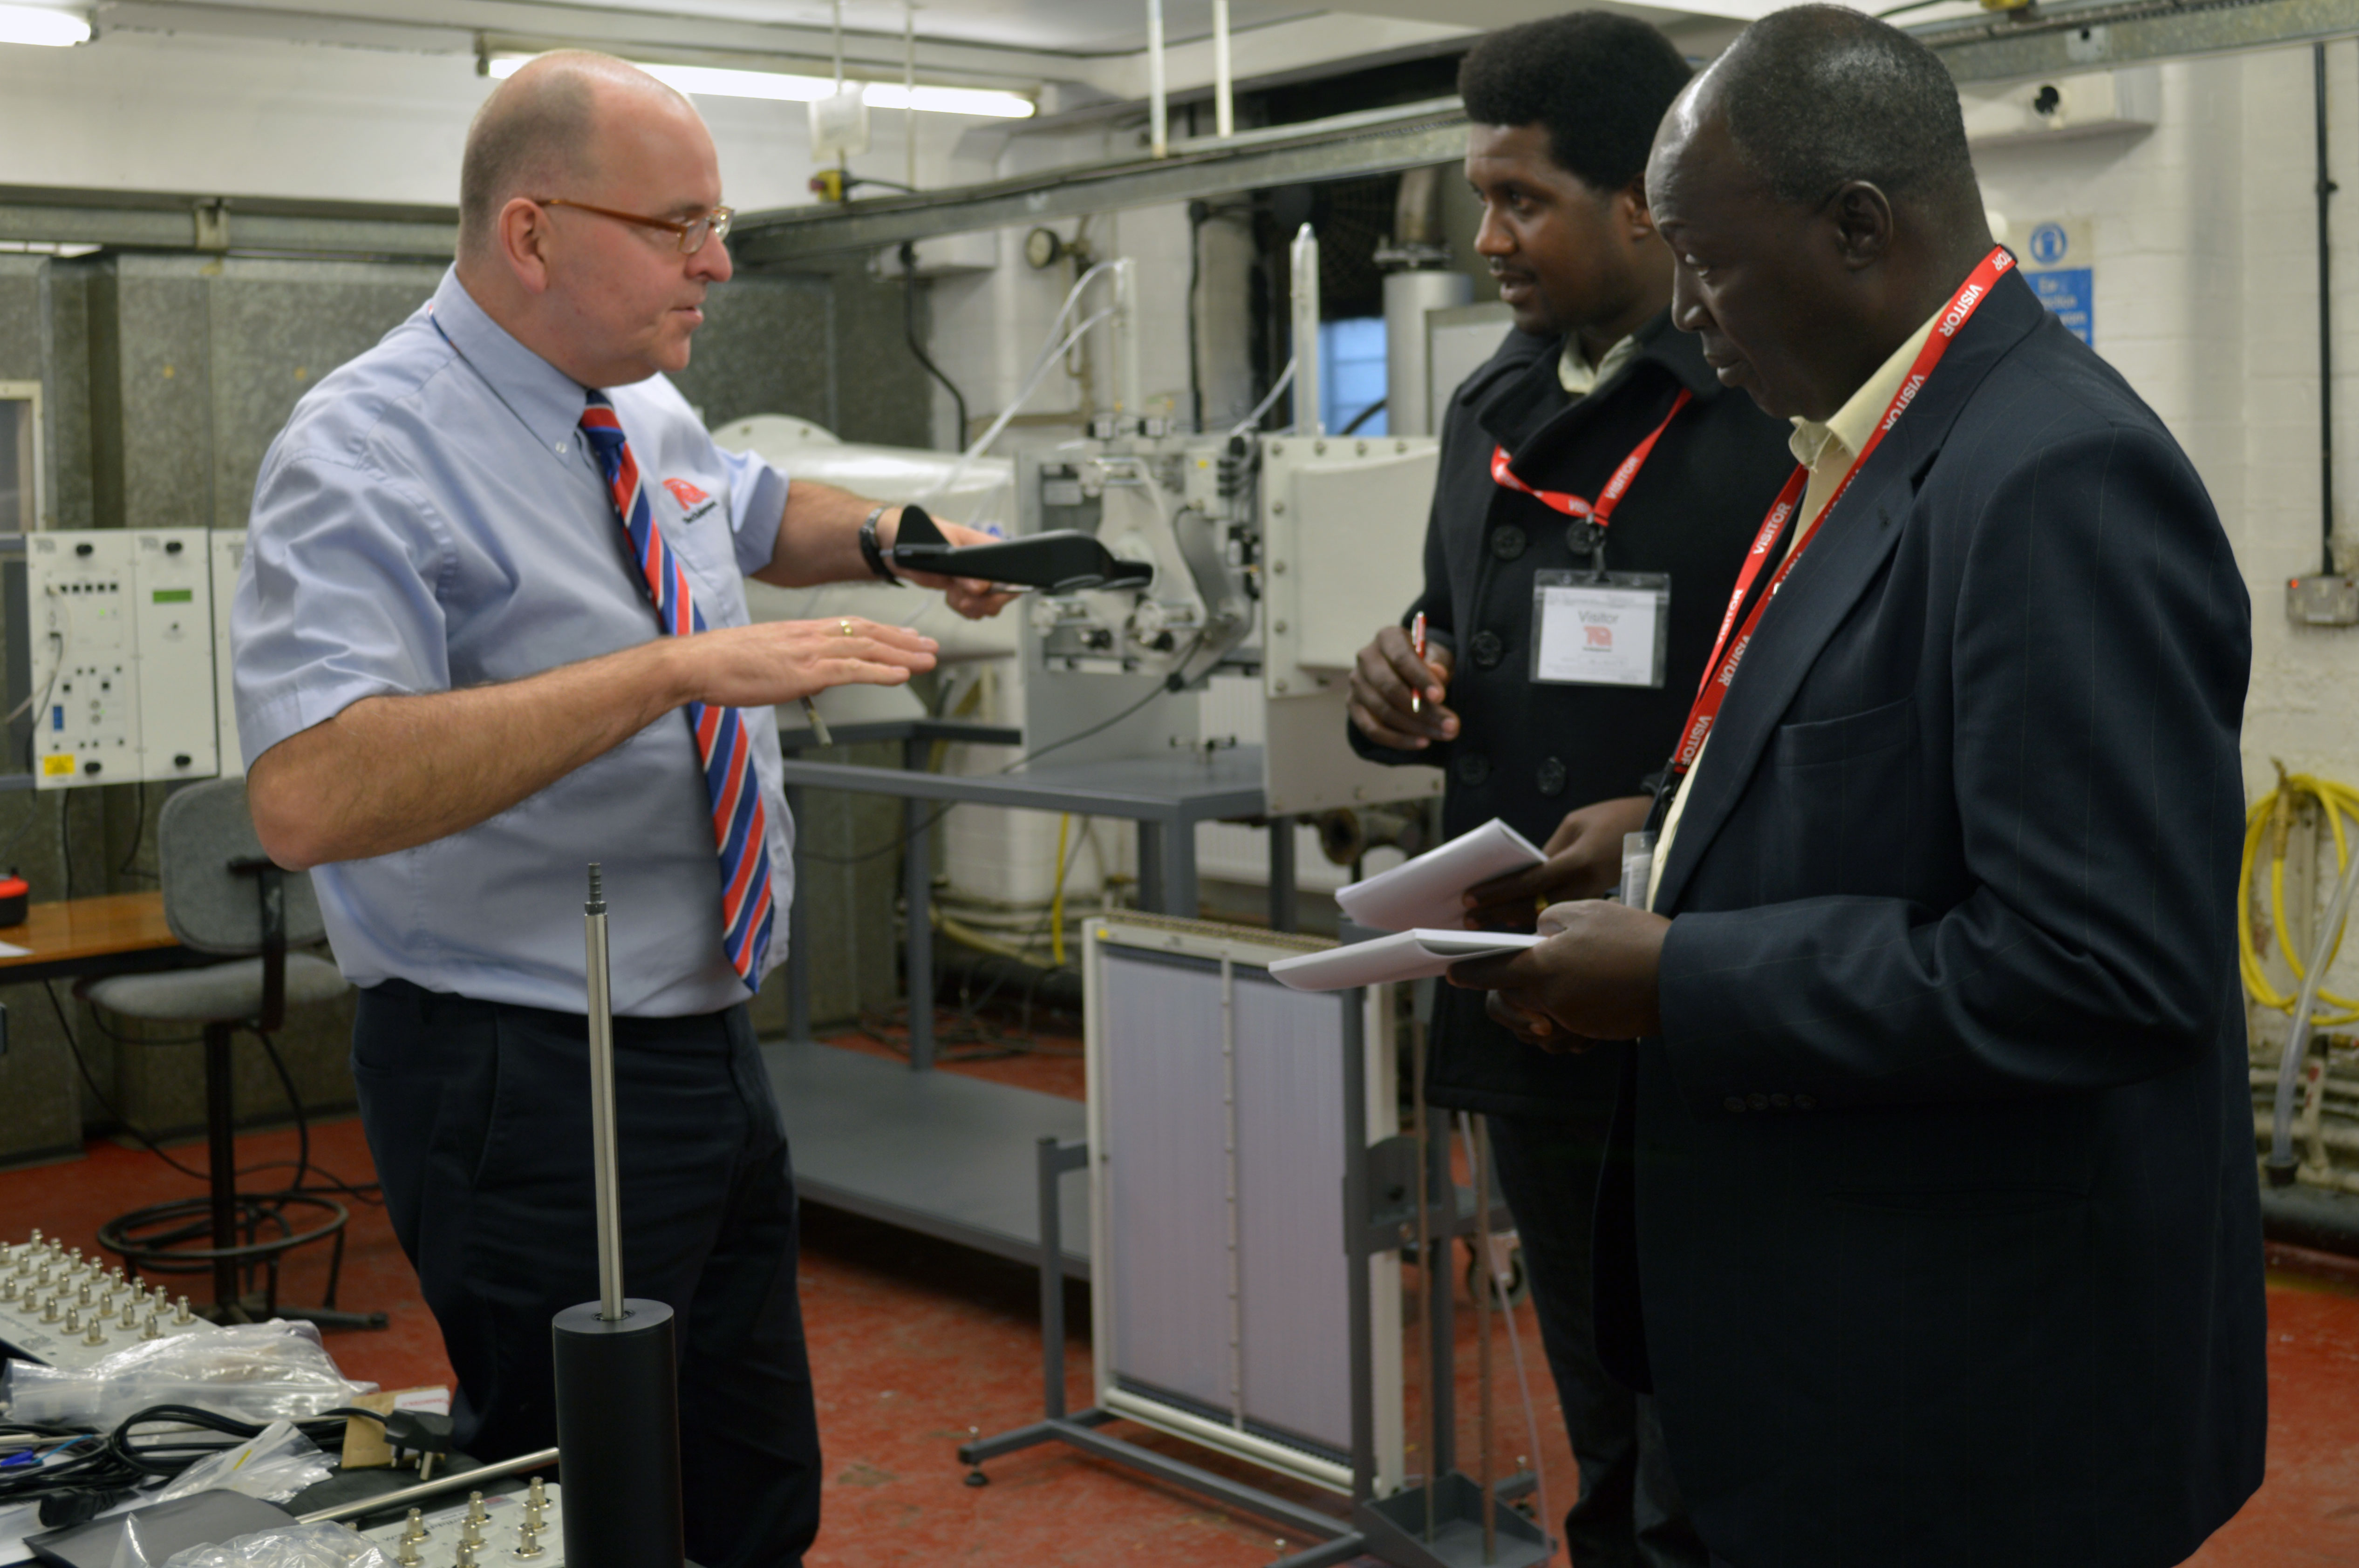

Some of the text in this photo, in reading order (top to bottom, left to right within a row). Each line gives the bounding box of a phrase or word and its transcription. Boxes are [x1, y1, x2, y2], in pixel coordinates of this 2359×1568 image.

[1938, 284, 1983, 337] VISITOR
[1882, 374, 1925, 430] VISITOR
[1605, 456, 1639, 500] VISITOR
[1753, 502, 1792, 555] VISITOR
[1578, 610, 1619, 624] Visitor
[1716, 589, 1743, 645] VISITOR
[1717, 635, 1751, 687] VISITOR
